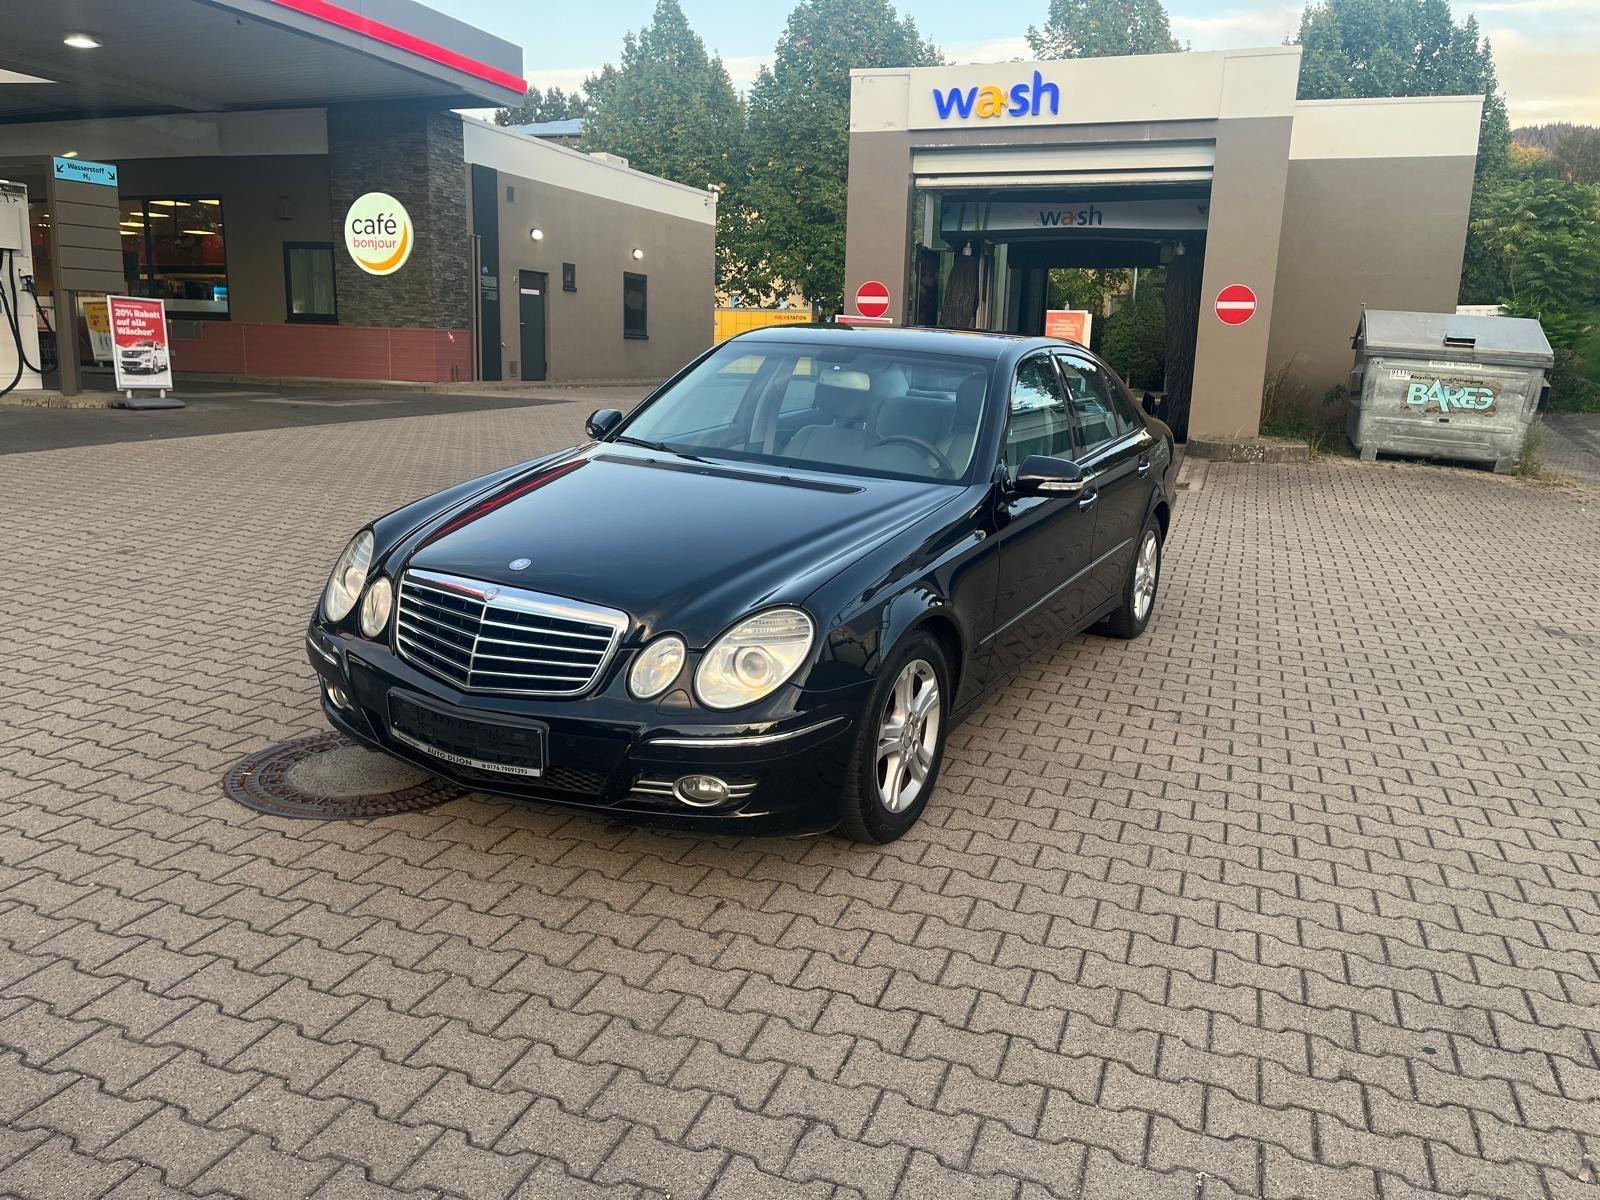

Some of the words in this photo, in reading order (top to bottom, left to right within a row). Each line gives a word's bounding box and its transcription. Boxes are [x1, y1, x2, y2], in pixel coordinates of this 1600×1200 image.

[932, 70, 1060, 119] wash
[66, 162, 105, 174] Wasserstoff
[351, 213, 397, 235] café
[1039, 204, 1103, 226] wash
[353, 237, 397, 250] bonjour
[115, 309, 133, 317] 20%
[133, 310, 160, 319] Rabatt
[116, 318, 130, 326] auf
[131, 318, 147, 327] alle
[1407, 380, 1494, 412] BAREG
[427, 747, 446, 759] AUTO
[447, 754, 472, 766] DIJON
